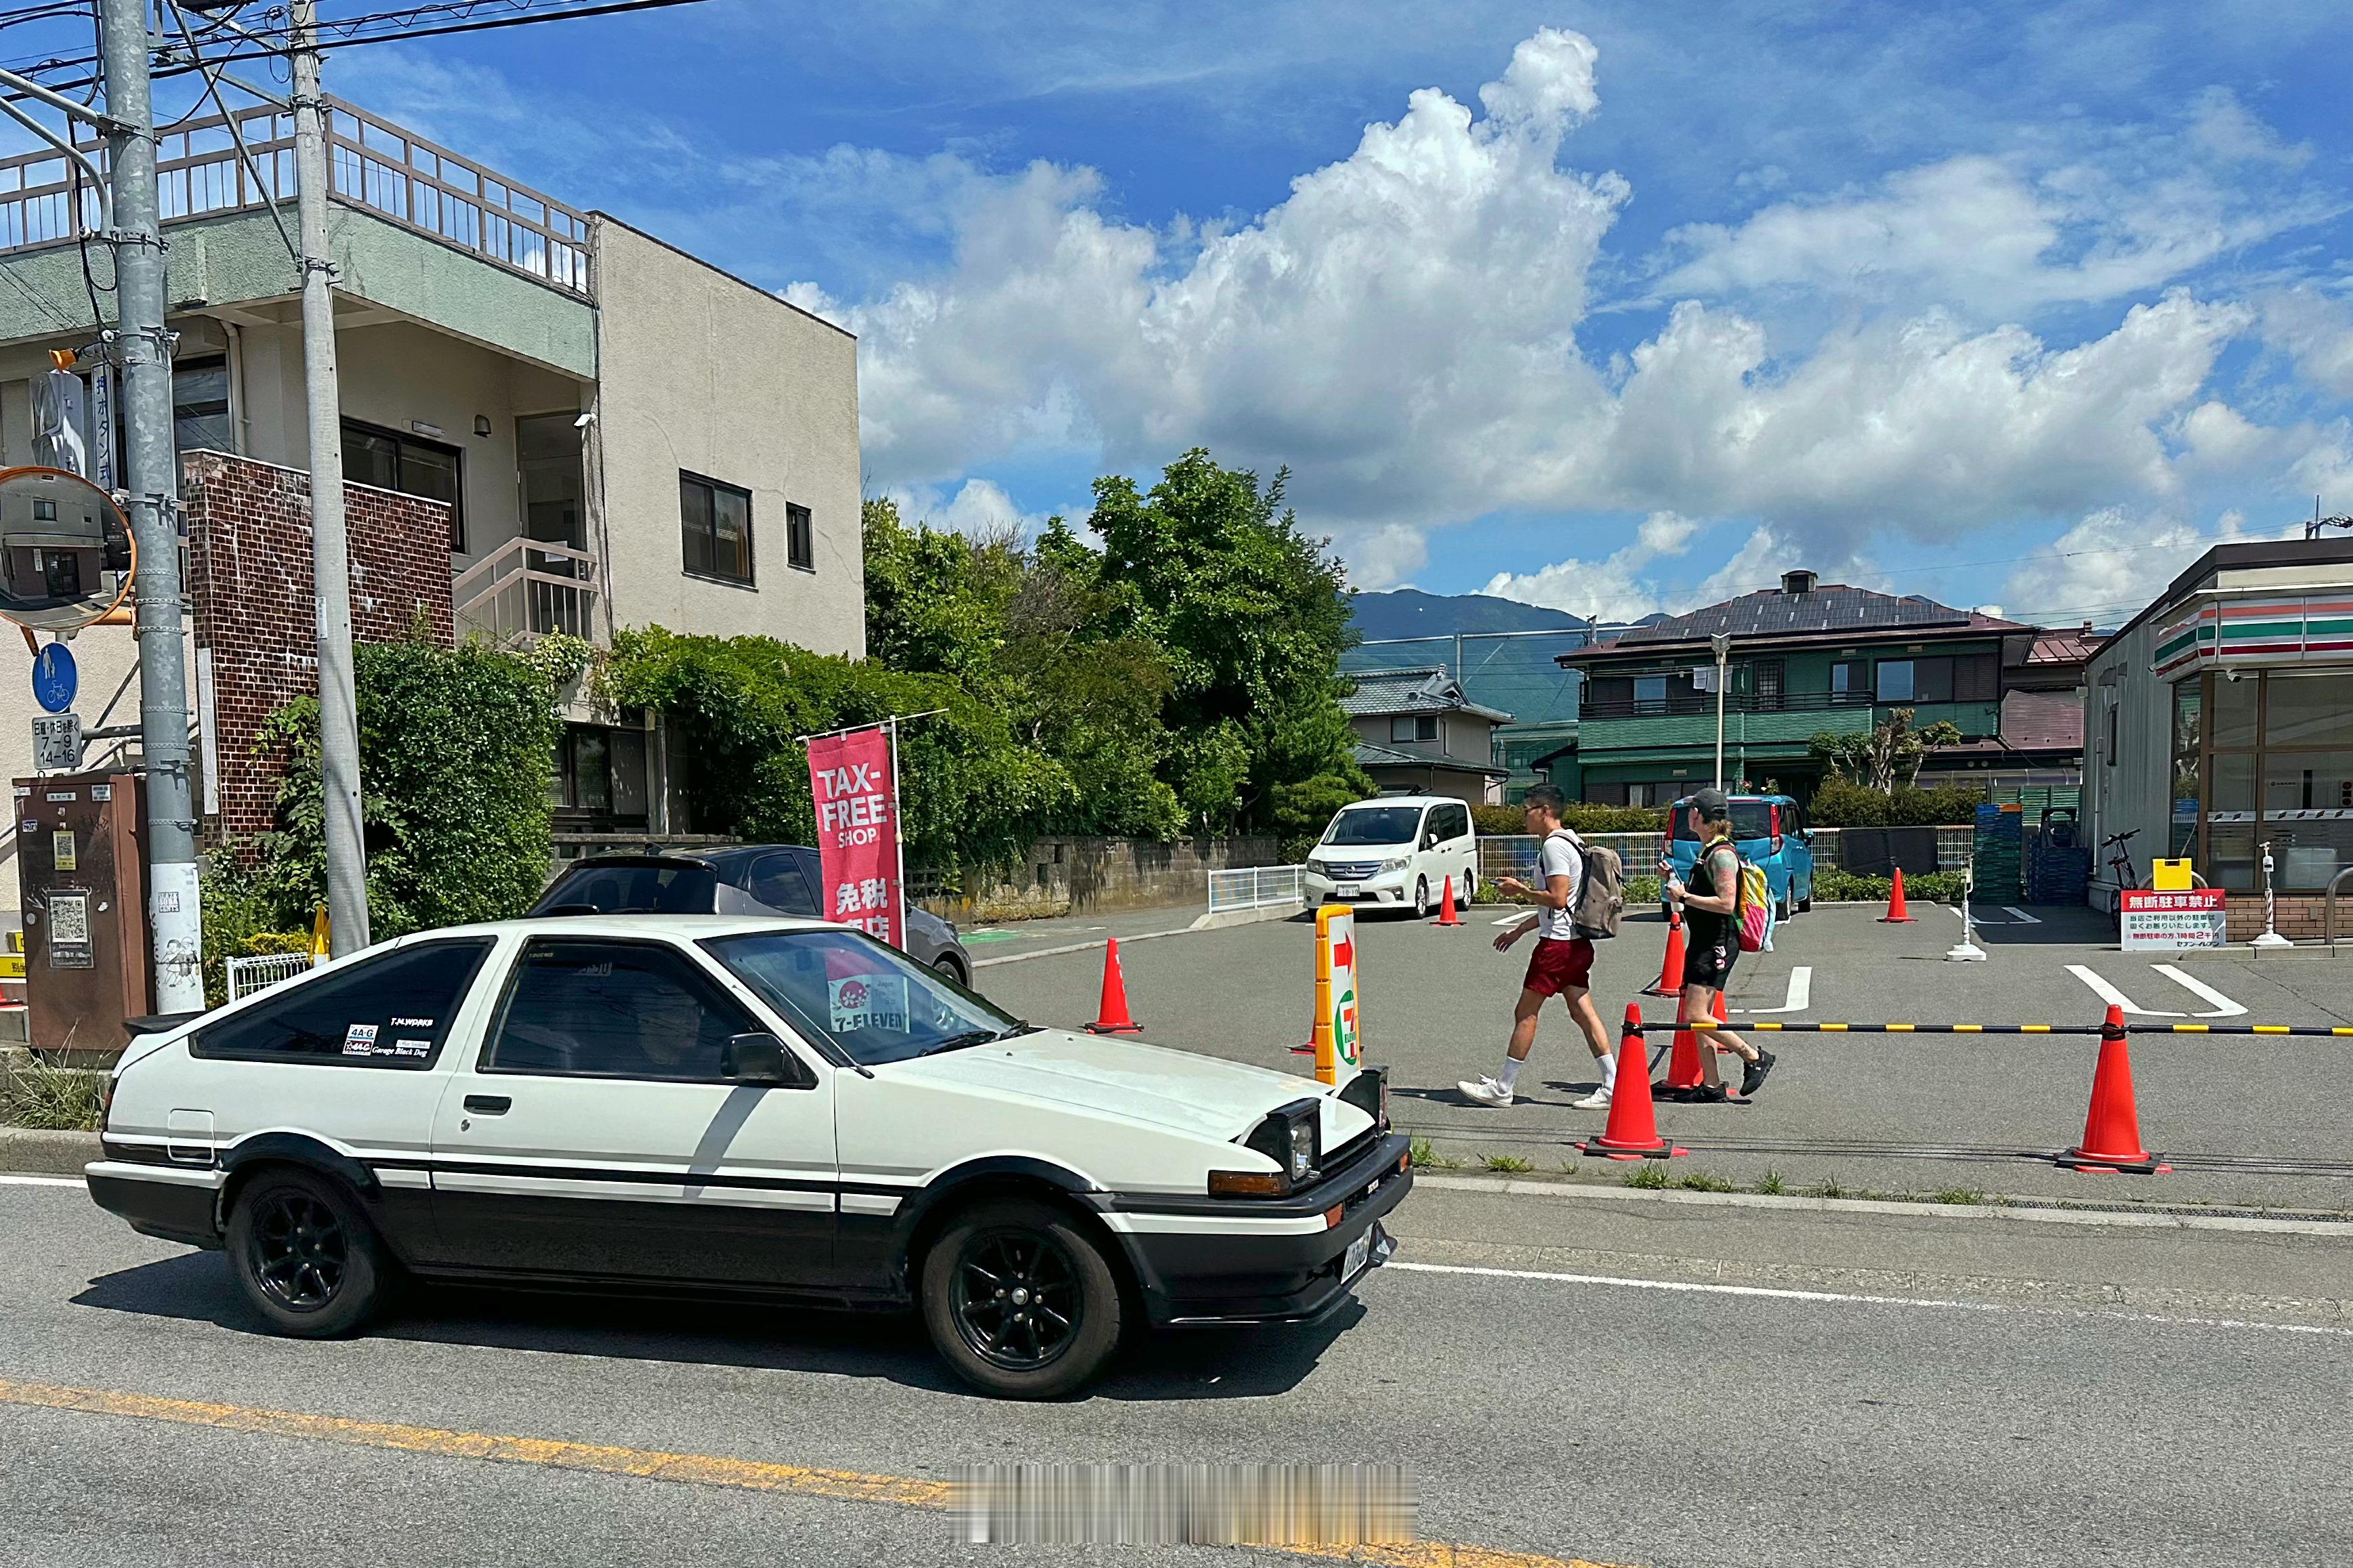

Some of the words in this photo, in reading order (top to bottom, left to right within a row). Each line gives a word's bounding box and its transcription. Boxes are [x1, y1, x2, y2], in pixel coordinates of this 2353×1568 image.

[816, 763, 881, 799] TAX-
[821, 794, 888, 832] FREE
[838, 827, 877, 849] SHOP
[836, 878, 888, 915] 免税
[2129, 895, 2218, 909] 無断駐車禁止
[372, 1046, 394, 1056] Garage
[394, 1047, 413, 1055] Black
[413, 1048, 428, 1058] Dog
